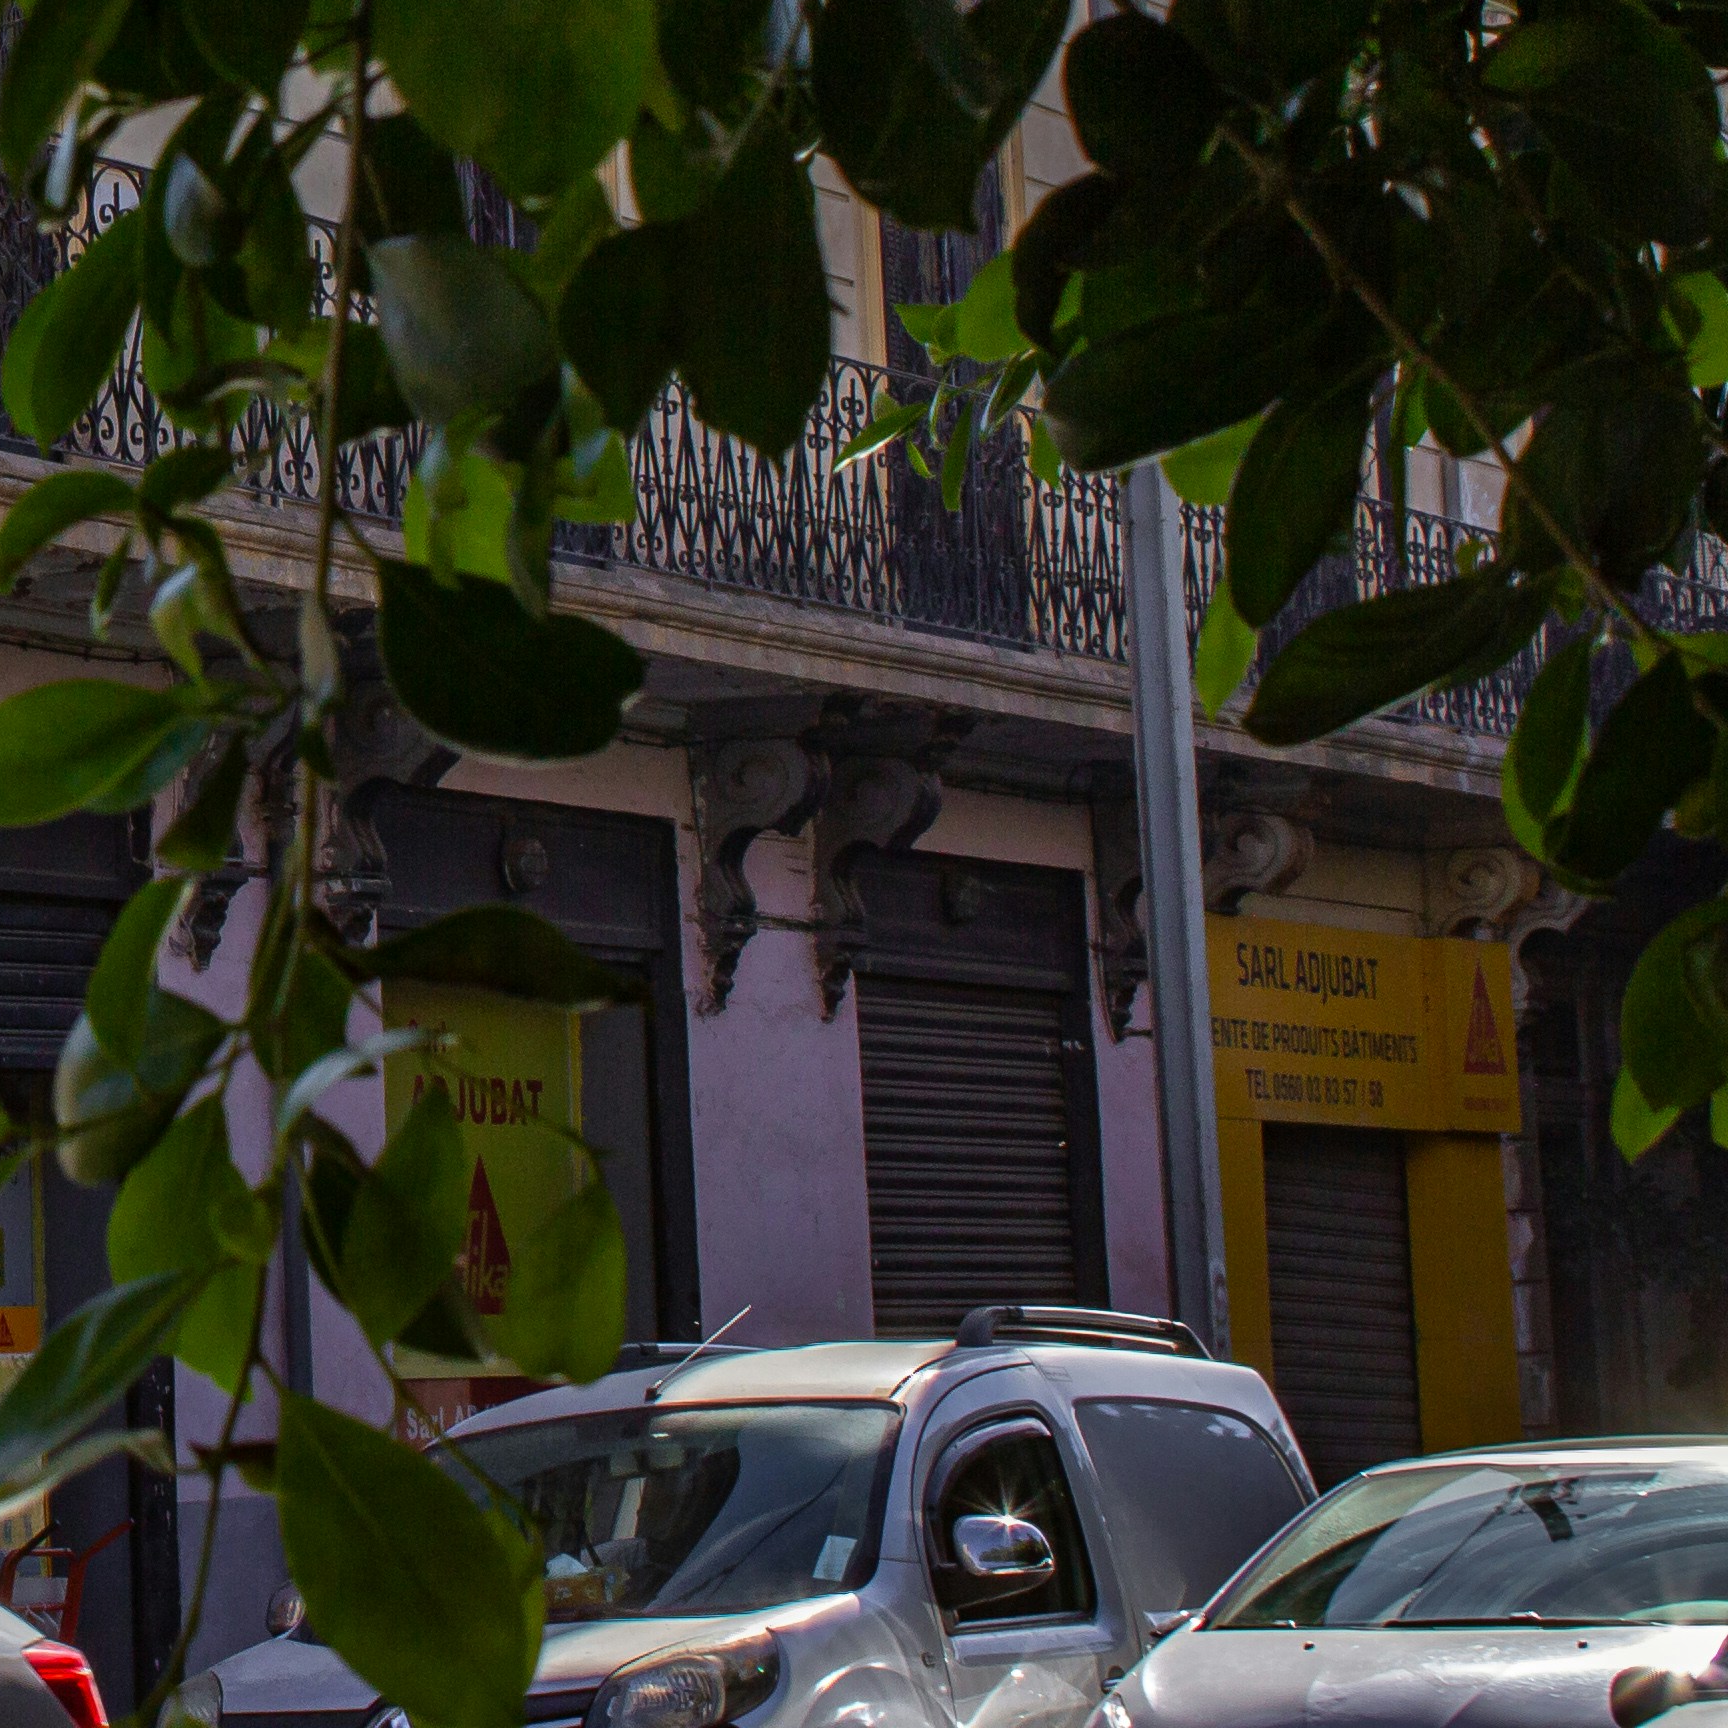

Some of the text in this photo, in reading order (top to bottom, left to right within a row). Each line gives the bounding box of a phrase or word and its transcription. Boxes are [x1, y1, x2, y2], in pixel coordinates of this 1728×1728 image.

[1236, 942, 1378, 1005] SARL ADJUBAT
[1212, 1017, 1248, 1049] ENTE
[1252, 1020, 1269, 1051] DE
[1273, 1023, 1339, 1057] PRODUITS
